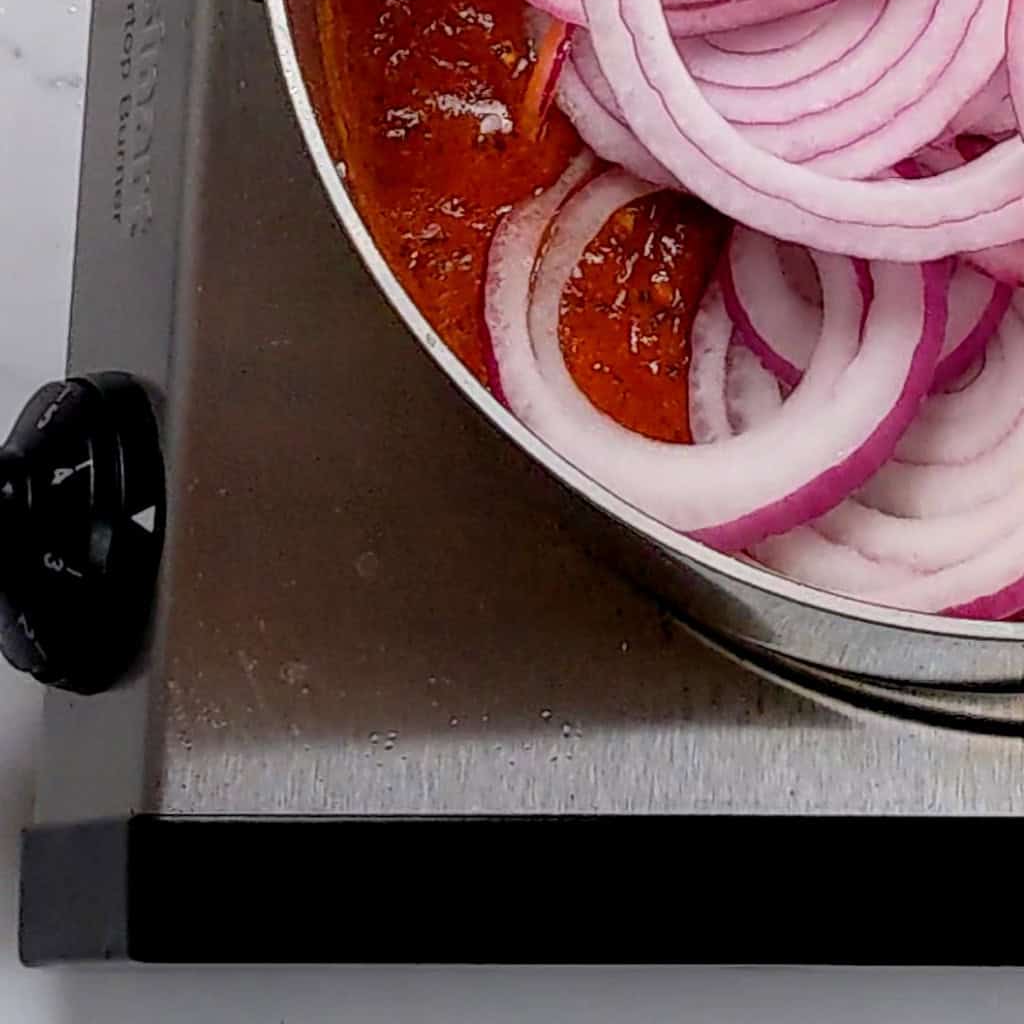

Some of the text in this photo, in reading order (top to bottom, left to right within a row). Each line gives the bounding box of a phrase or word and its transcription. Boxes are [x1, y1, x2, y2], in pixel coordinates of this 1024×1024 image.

[112, 93, 132, 223] Burner
[50, 468, 75, 486] 4
[43, 552, 64, 571] 3
